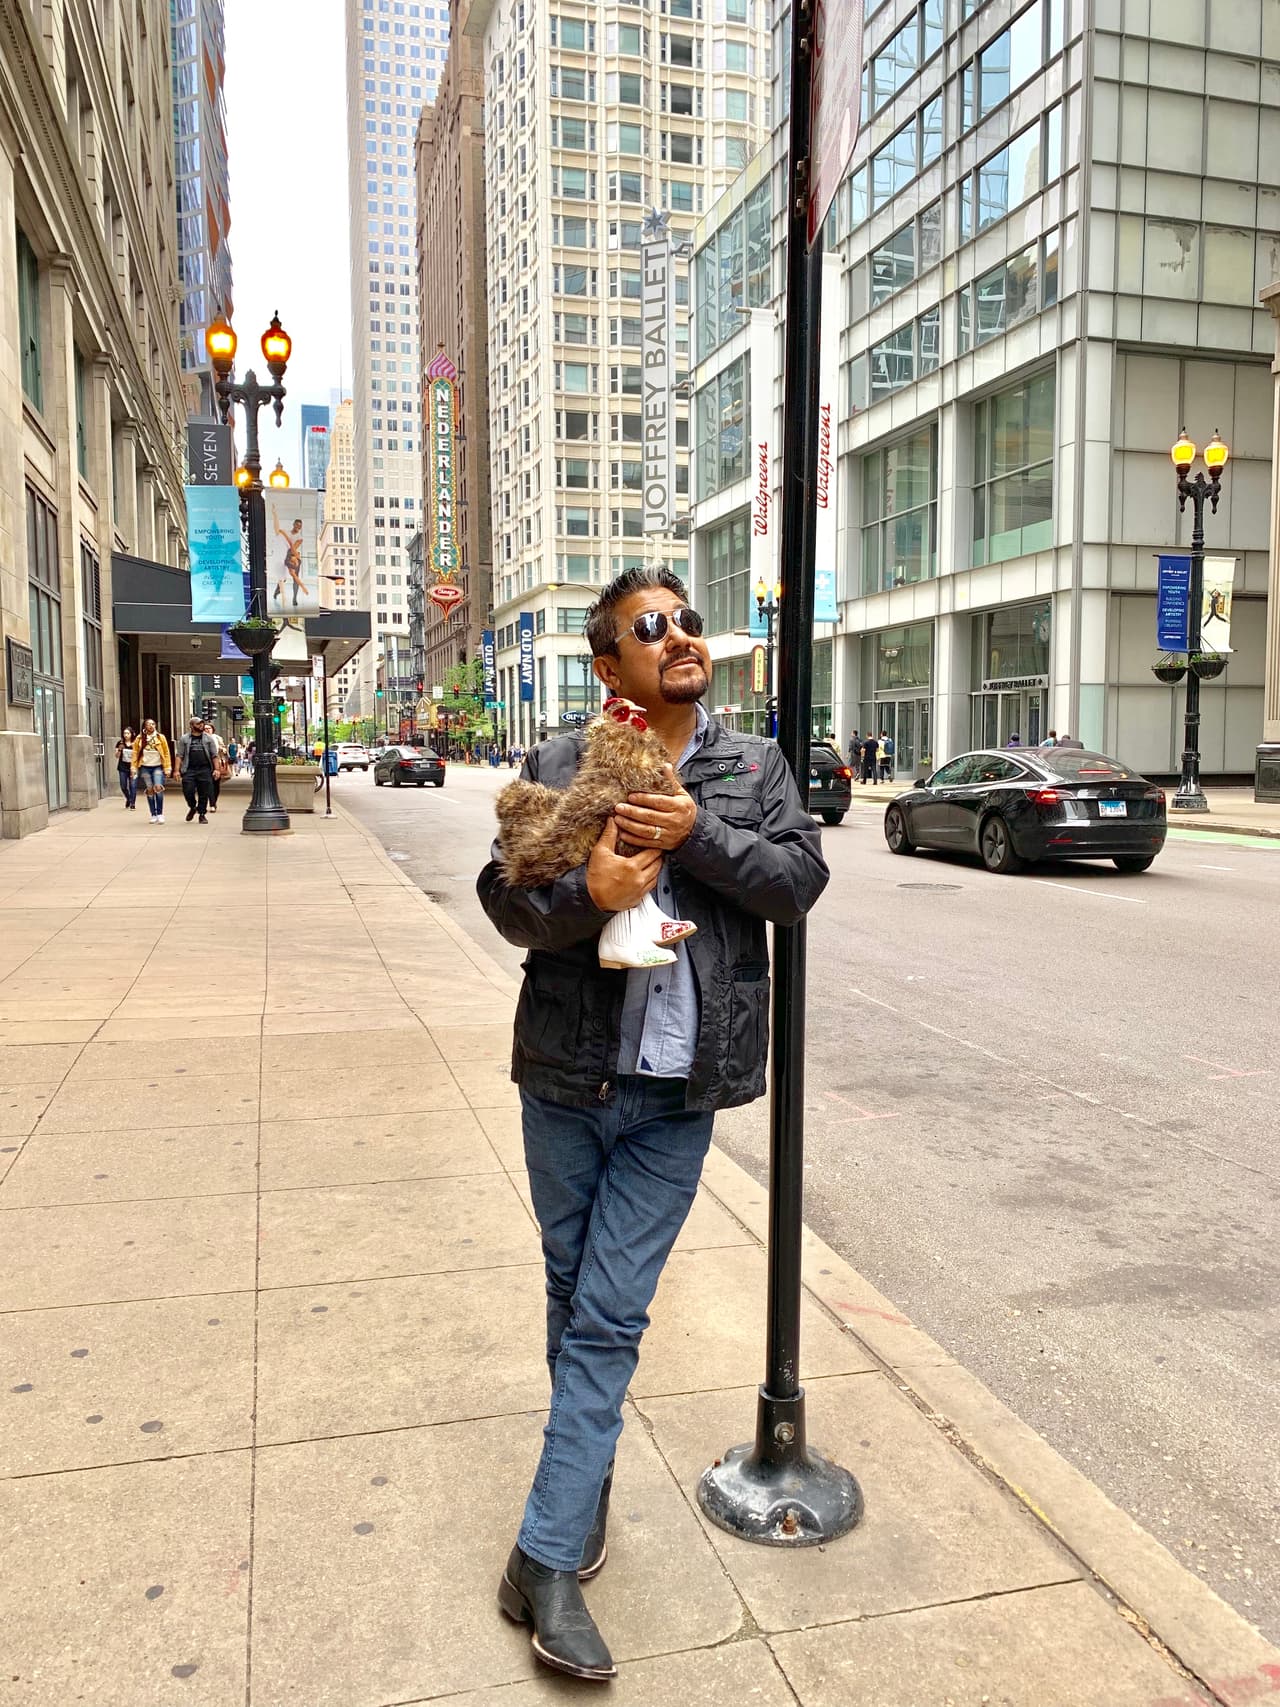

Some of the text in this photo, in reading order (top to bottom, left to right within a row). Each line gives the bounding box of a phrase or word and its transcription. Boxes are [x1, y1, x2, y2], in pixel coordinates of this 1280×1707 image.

[644, 248, 667, 526] JOFFREY BALLET
[203, 431, 219, 481] SEVEN
[436, 389, 453, 567] NEDERLANDER
[754, 441, 772, 537] Walgreens
[816, 402, 835, 509] Walgreens
[484, 645, 494, 664] OLD
[521, 630, 533, 685] OLD NAVY
